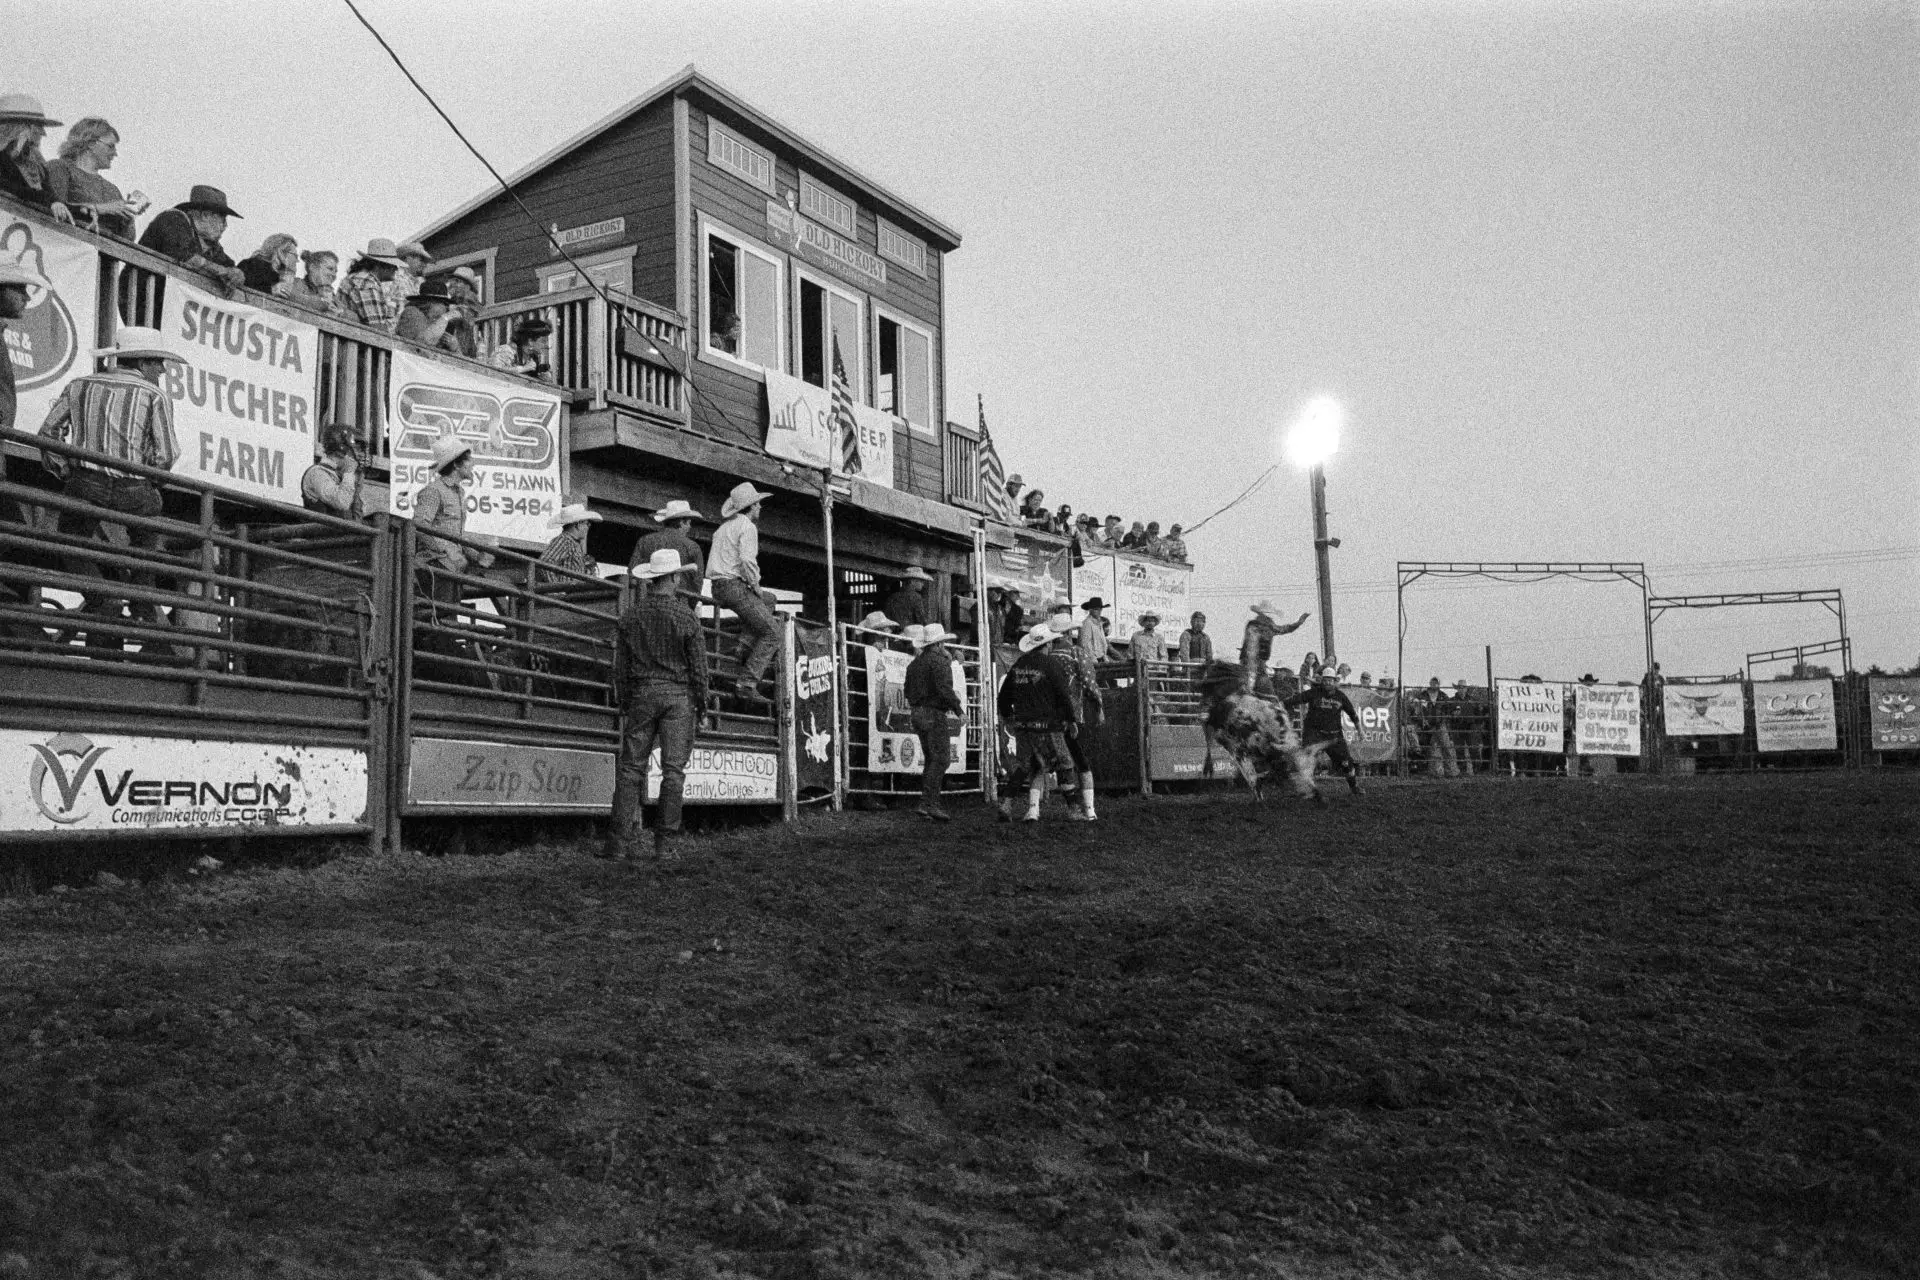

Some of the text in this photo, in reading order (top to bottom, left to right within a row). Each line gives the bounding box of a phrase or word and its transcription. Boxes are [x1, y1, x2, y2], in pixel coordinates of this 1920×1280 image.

[566, 219, 622, 243] OLD HICKORY
[806, 223, 884, 280] OLD HICKORY
[181, 299, 303, 374] SHUSTA
[164, 359, 309, 434] BUTCHER
[199, 431, 285, 489] FARM
[492, 471, 555, 493] SHAWN
[1131, 591, 1173, 609] COUNTRY
[1501, 701, 1560, 713] CATERING
[1502, 719, 1558, 733] MT. ZION
[1584, 722, 1629, 743] Shop
[1514, 733, 1547, 747] PUB
[648, 750, 775, 776] NHBORHOOD
[94, 768, 292, 807] VERNON
[684, 779, 753, 798] amily Clinics
[111, 808, 222, 824] Communications
